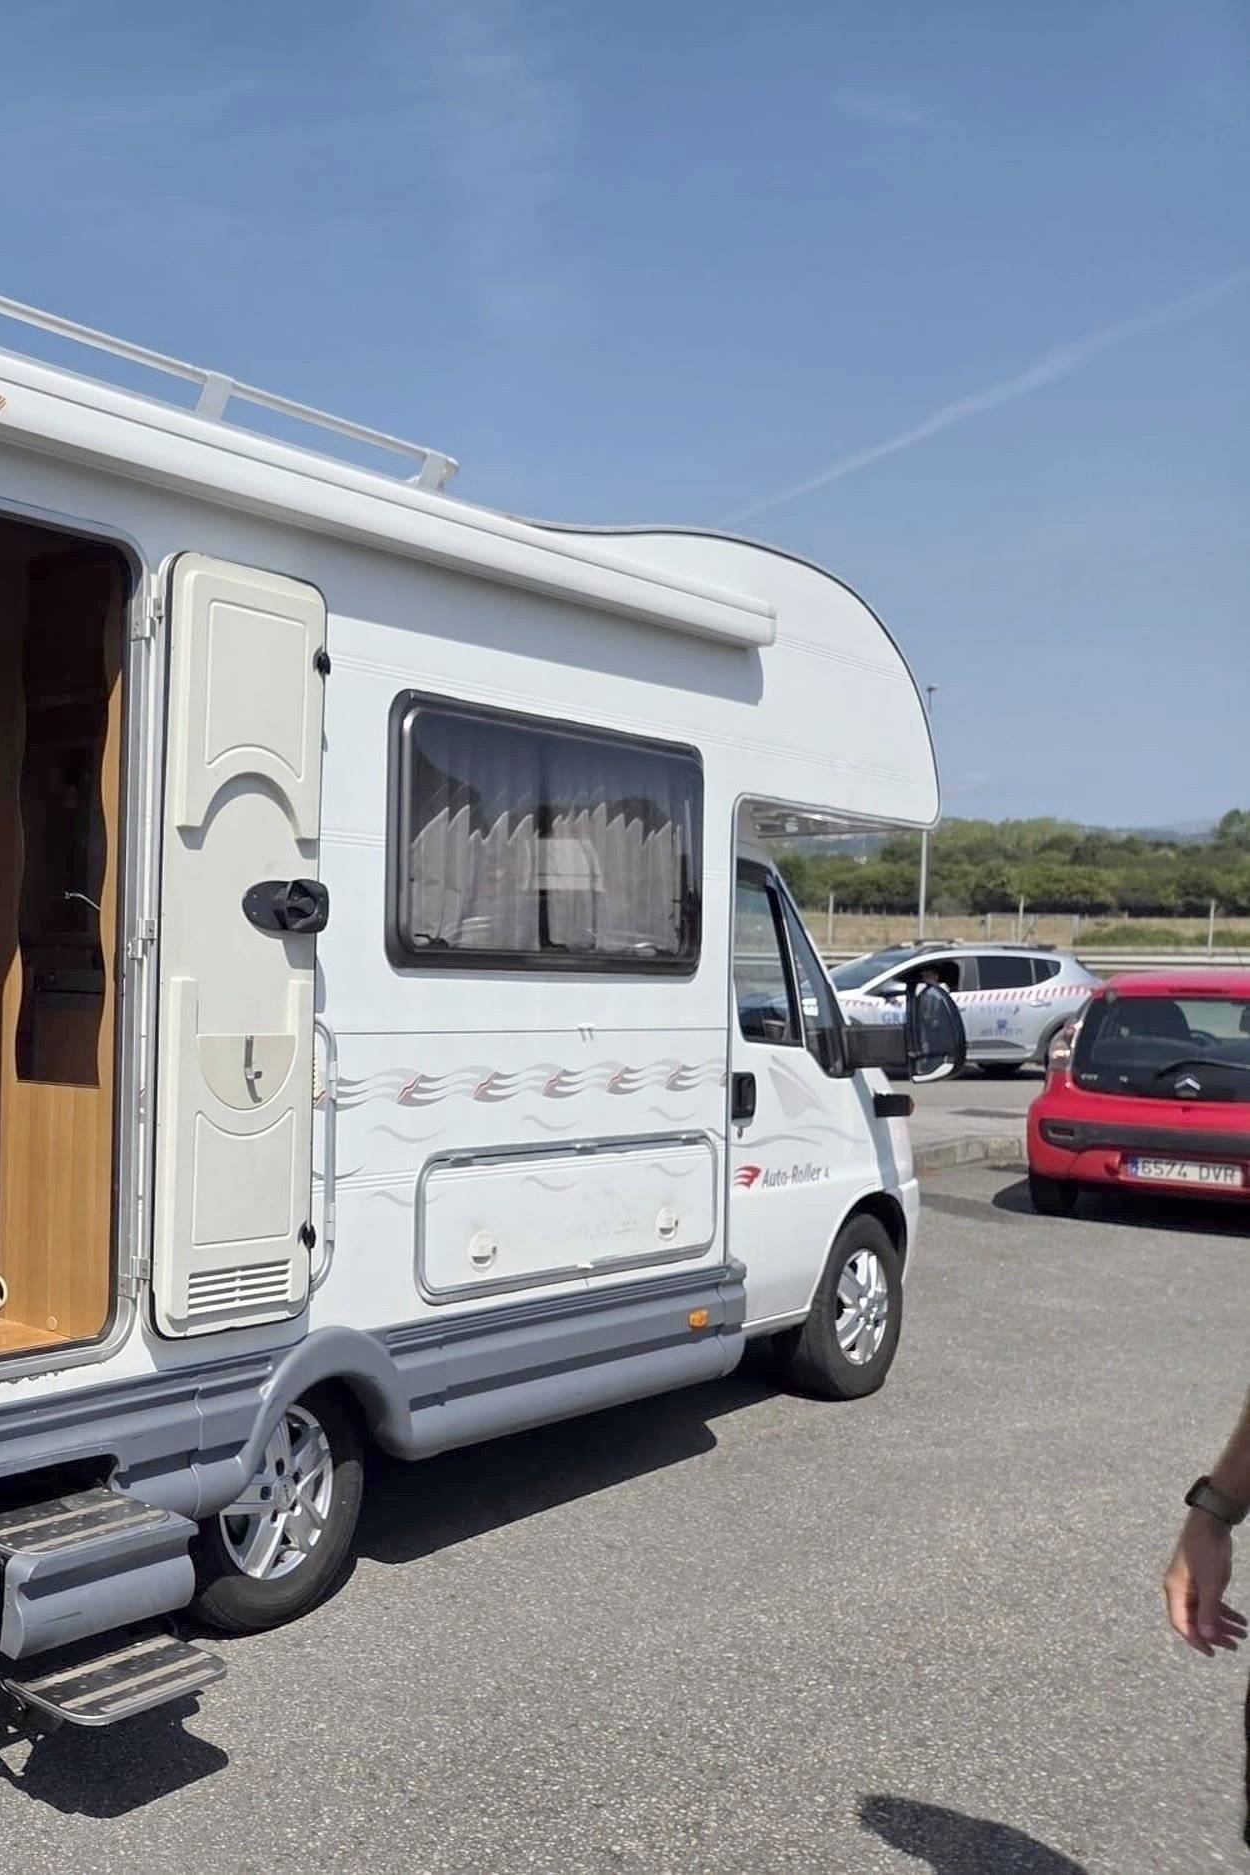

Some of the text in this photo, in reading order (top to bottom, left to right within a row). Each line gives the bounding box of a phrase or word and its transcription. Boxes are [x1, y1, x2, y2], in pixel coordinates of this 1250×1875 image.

[761, 1163, 821, 1188] Auto-Roller
[1141, 1160, 1236, 1183] 6574 DVR
